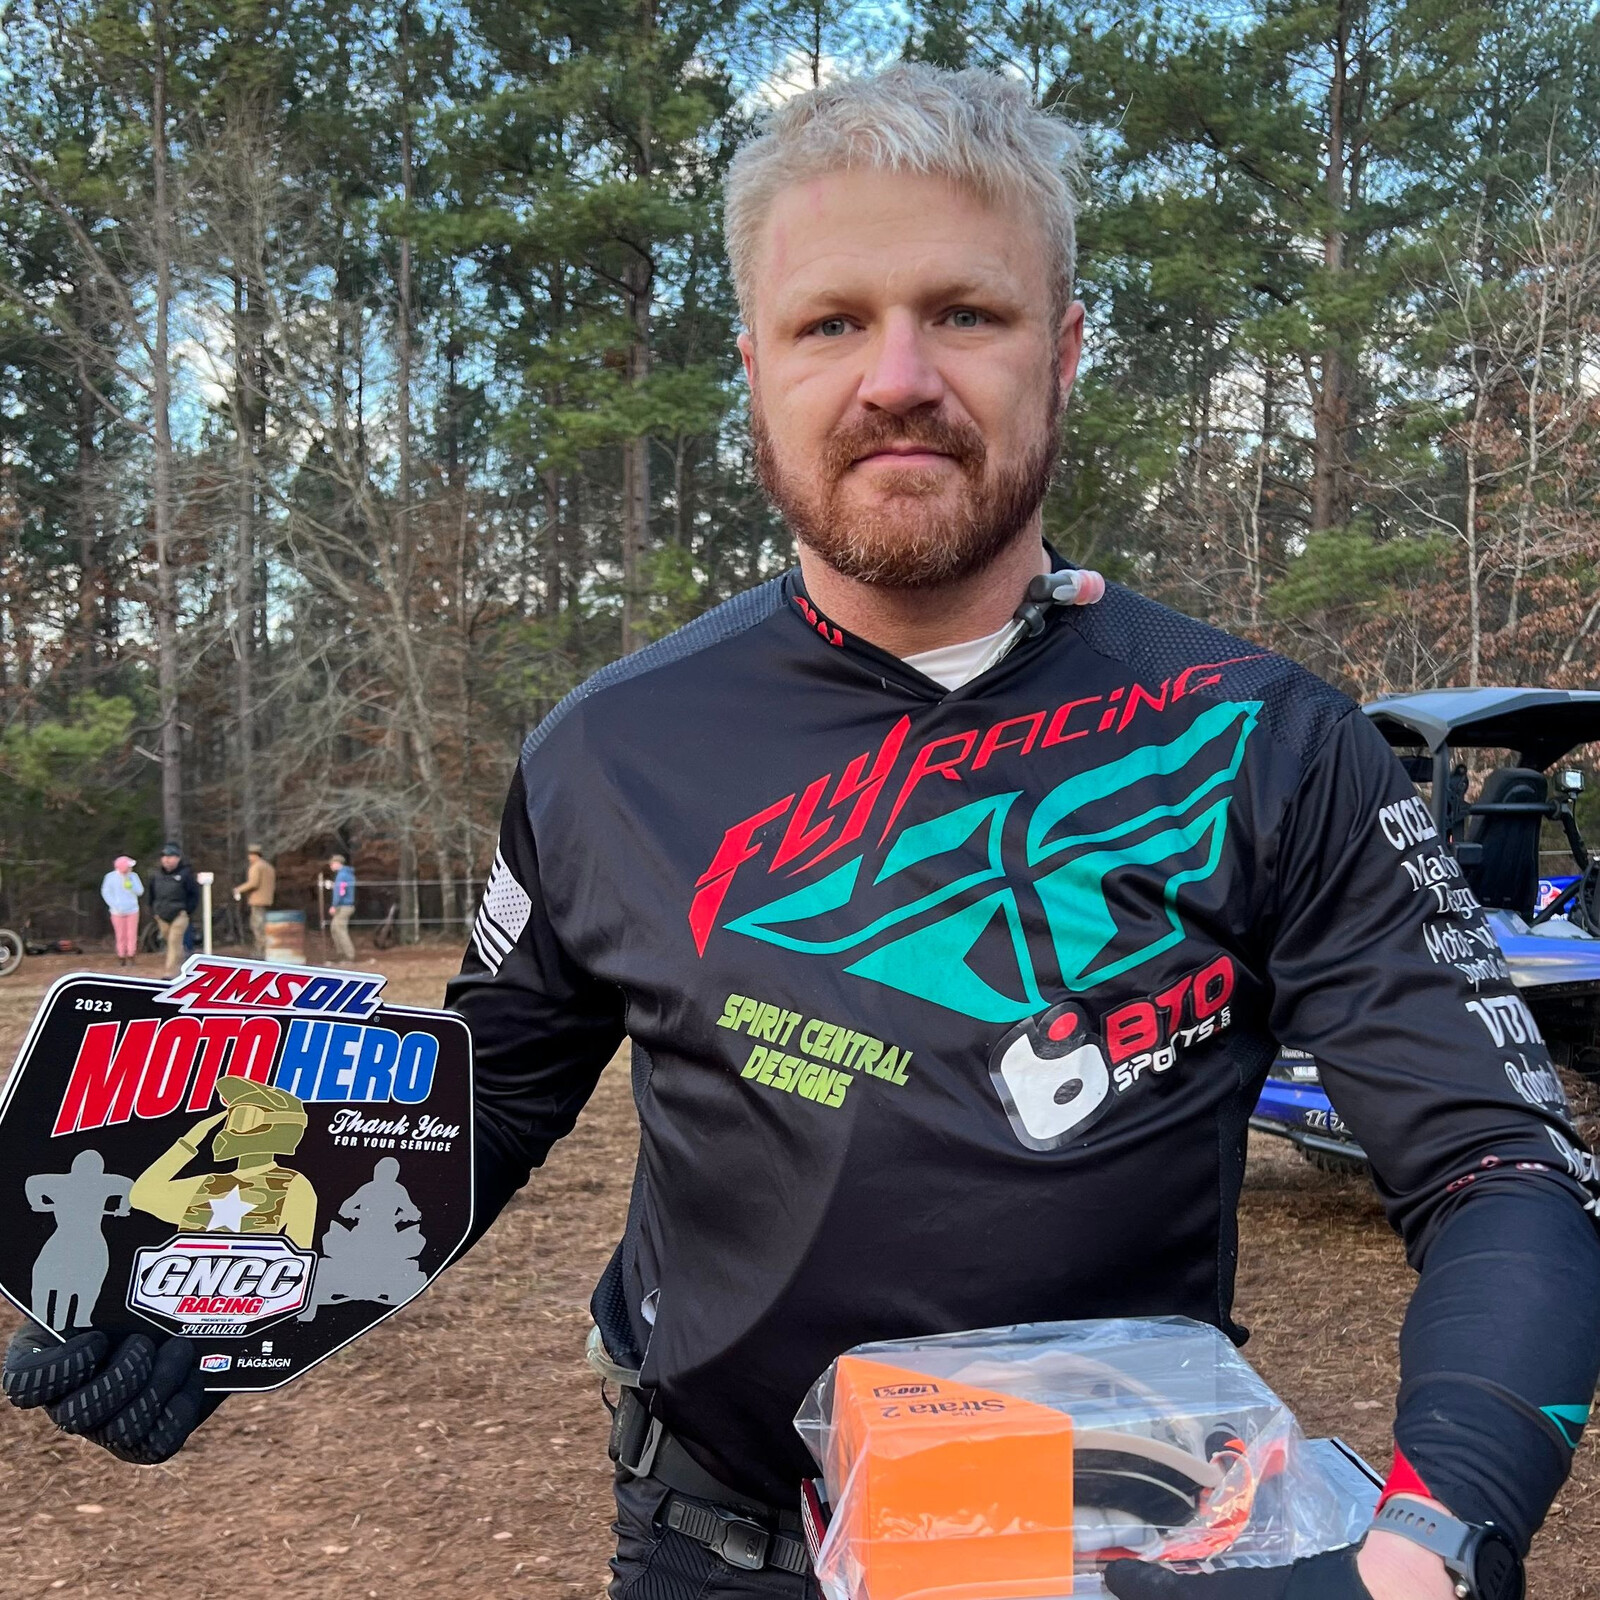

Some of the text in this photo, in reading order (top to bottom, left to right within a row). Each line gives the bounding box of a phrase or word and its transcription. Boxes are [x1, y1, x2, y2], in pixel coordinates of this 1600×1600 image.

[688, 714, 911, 959] FLY
[167, 963, 381, 1017] AMSOIL
[75, 998, 113, 1013] 2023
[1106, 955, 1235, 1065] BTO
[716, 993, 914, 1086] SPIRIT CENTRAL
[740, 1044, 855, 1109] DESIGNS
[328, 1108, 460, 1140] Thank You
[334, 1135, 452, 1152] FOR YOUR SERVICE
[141, 1255, 305, 1298] GNCC
[174, 1296, 265, 1315] RACING
[178, 1324, 248, 1335] SPECIALIZED
[204, 1358, 229, 1369] 100%
[236, 1358, 292, 1368] FLAG&SIGN
[883, 1386, 927, 1397] 100%
[881, 1405, 901, 1418] 2
[908, 1399, 1006, 1415] Strata
